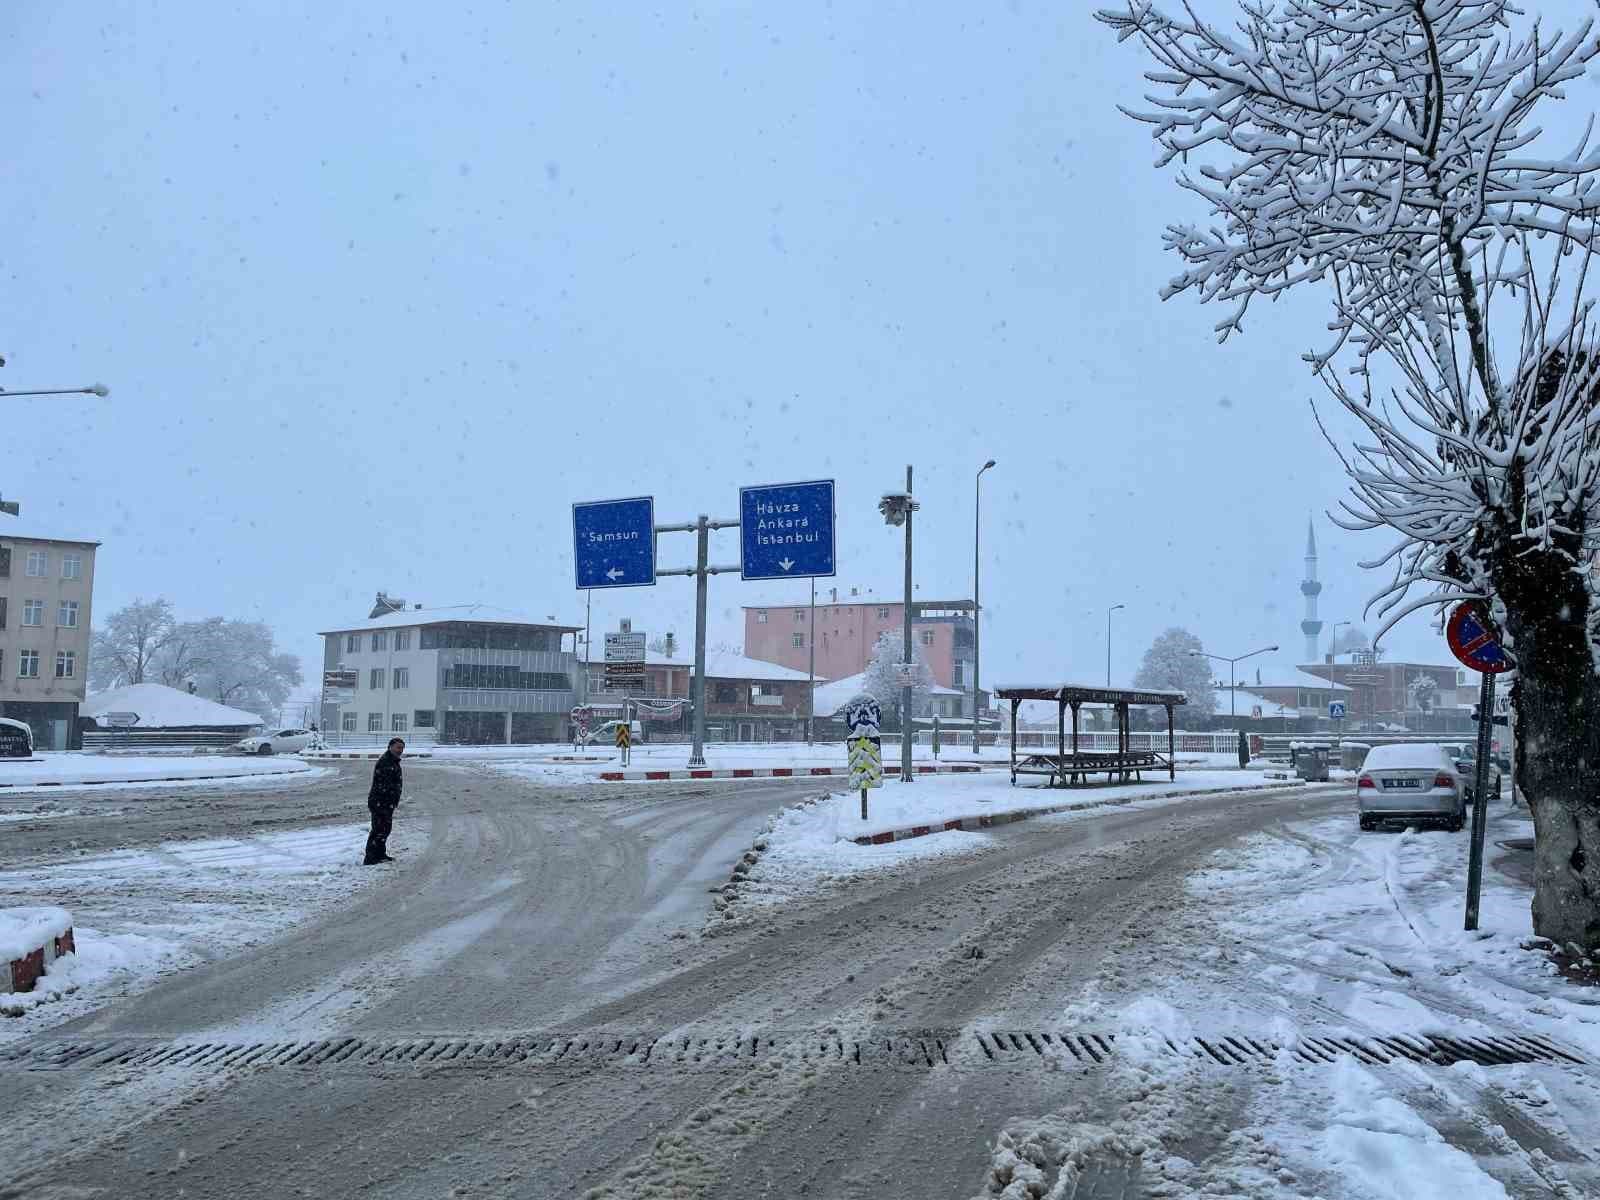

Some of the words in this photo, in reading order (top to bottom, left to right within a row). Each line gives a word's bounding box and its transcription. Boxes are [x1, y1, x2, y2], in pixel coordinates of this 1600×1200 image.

[757, 503, 800, 514] Havza
[758, 518, 809, 529] Ankara
[589, 531, 638, 542] Samsun
